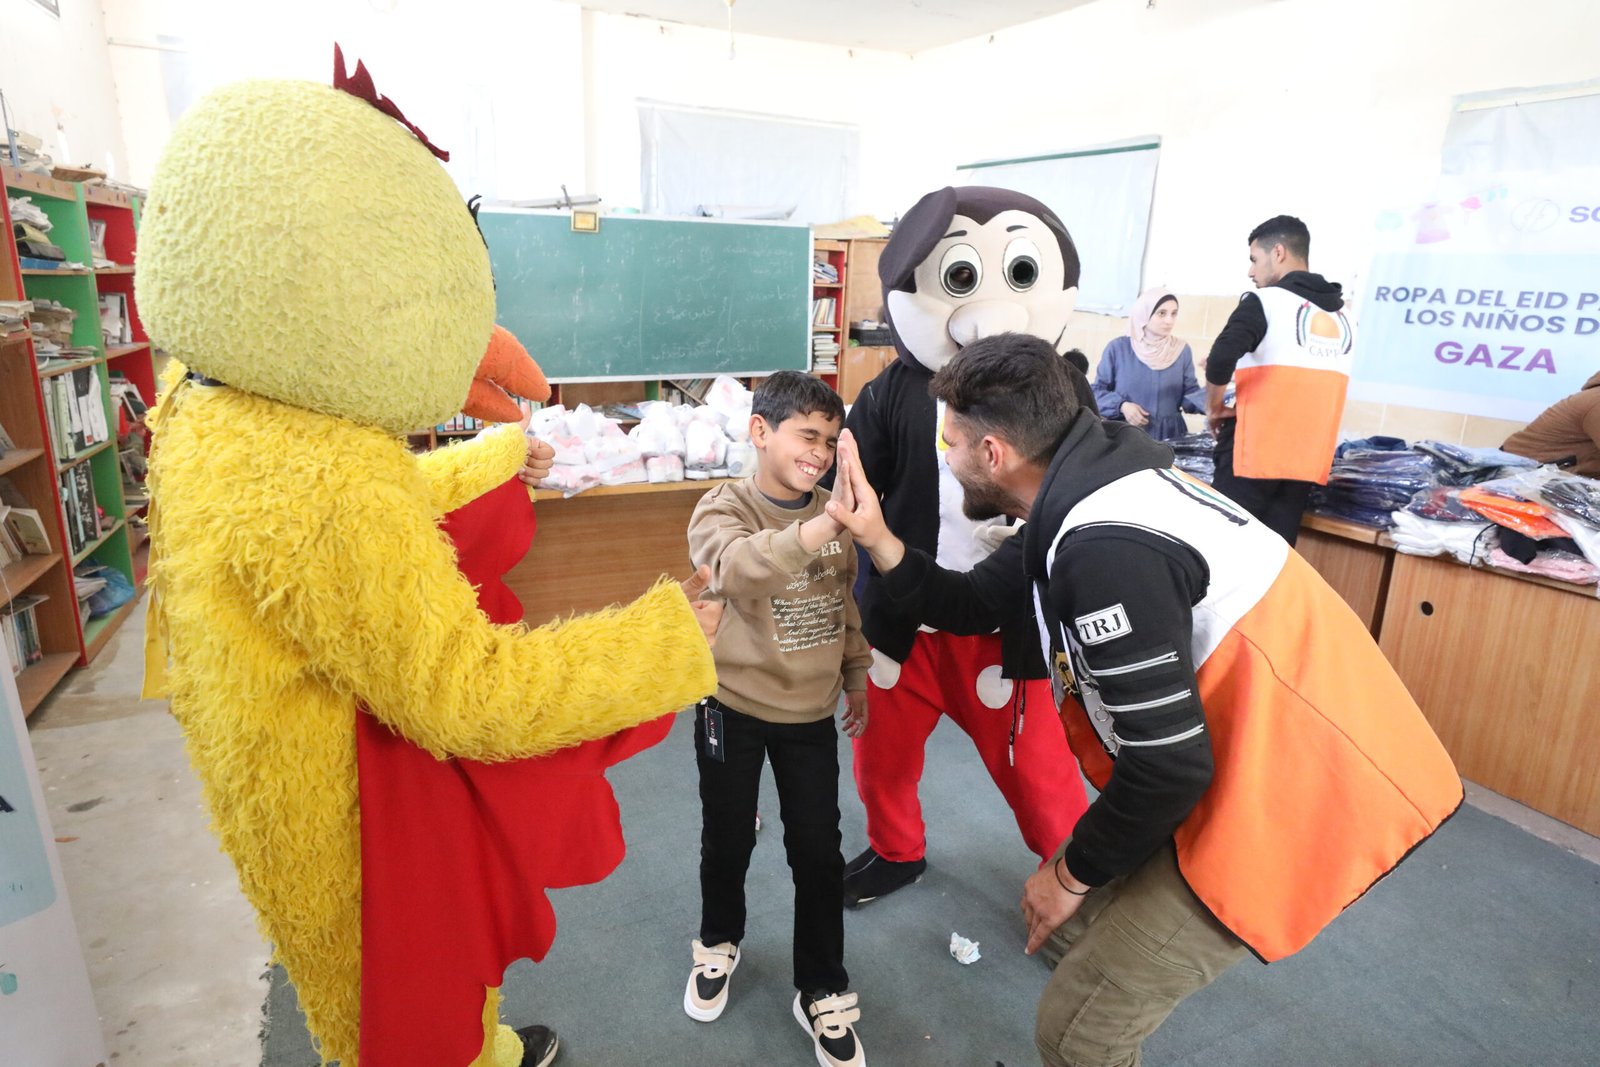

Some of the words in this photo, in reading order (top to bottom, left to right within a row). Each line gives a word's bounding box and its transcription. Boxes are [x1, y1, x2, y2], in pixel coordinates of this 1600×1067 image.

[1375, 286, 1446, 304] ROPA
[1455, 288, 1507, 307] DEL
[1516, 290, 1568, 309] EID
[1576, 293, 1600, 311] P
[1404, 308, 1455, 327] LOS
[1462, 309, 1566, 334] NIÑOS
[1434, 341, 1557, 374] GAZA
[1080, 613, 1122, 640] TRJ
